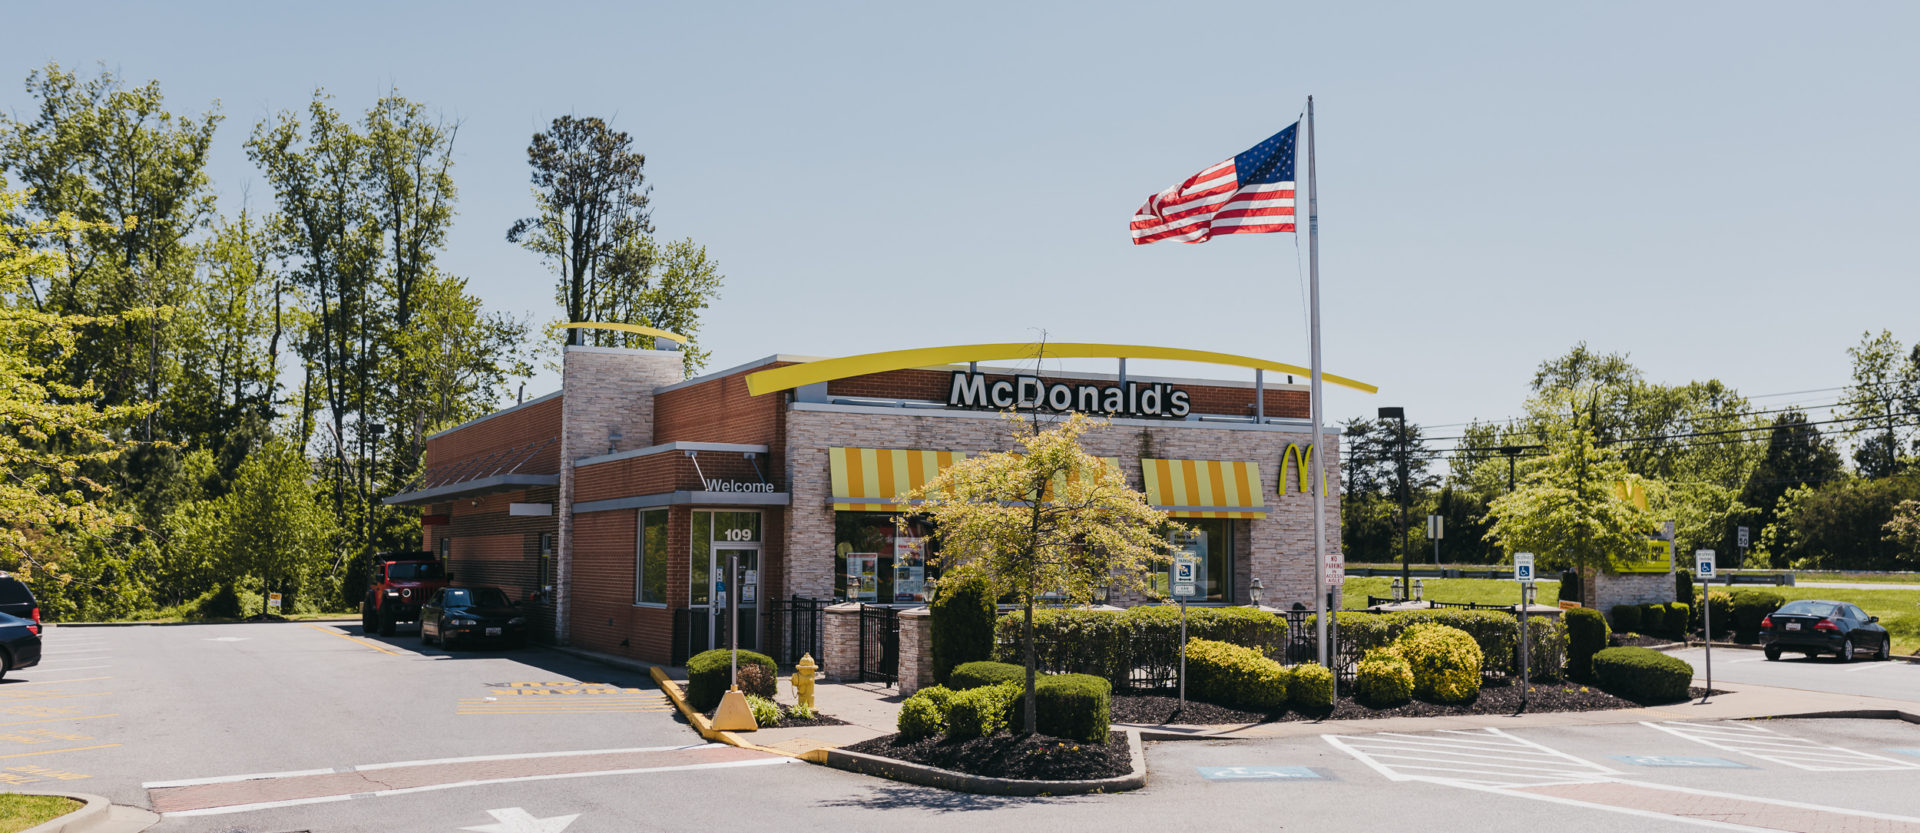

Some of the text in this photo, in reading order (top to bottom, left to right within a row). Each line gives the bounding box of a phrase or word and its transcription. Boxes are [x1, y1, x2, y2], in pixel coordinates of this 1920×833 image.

[949, 371, 1191, 418] McDonald's
[706, 478, 775, 494] Welcome
[724, 528, 752, 541] 109
